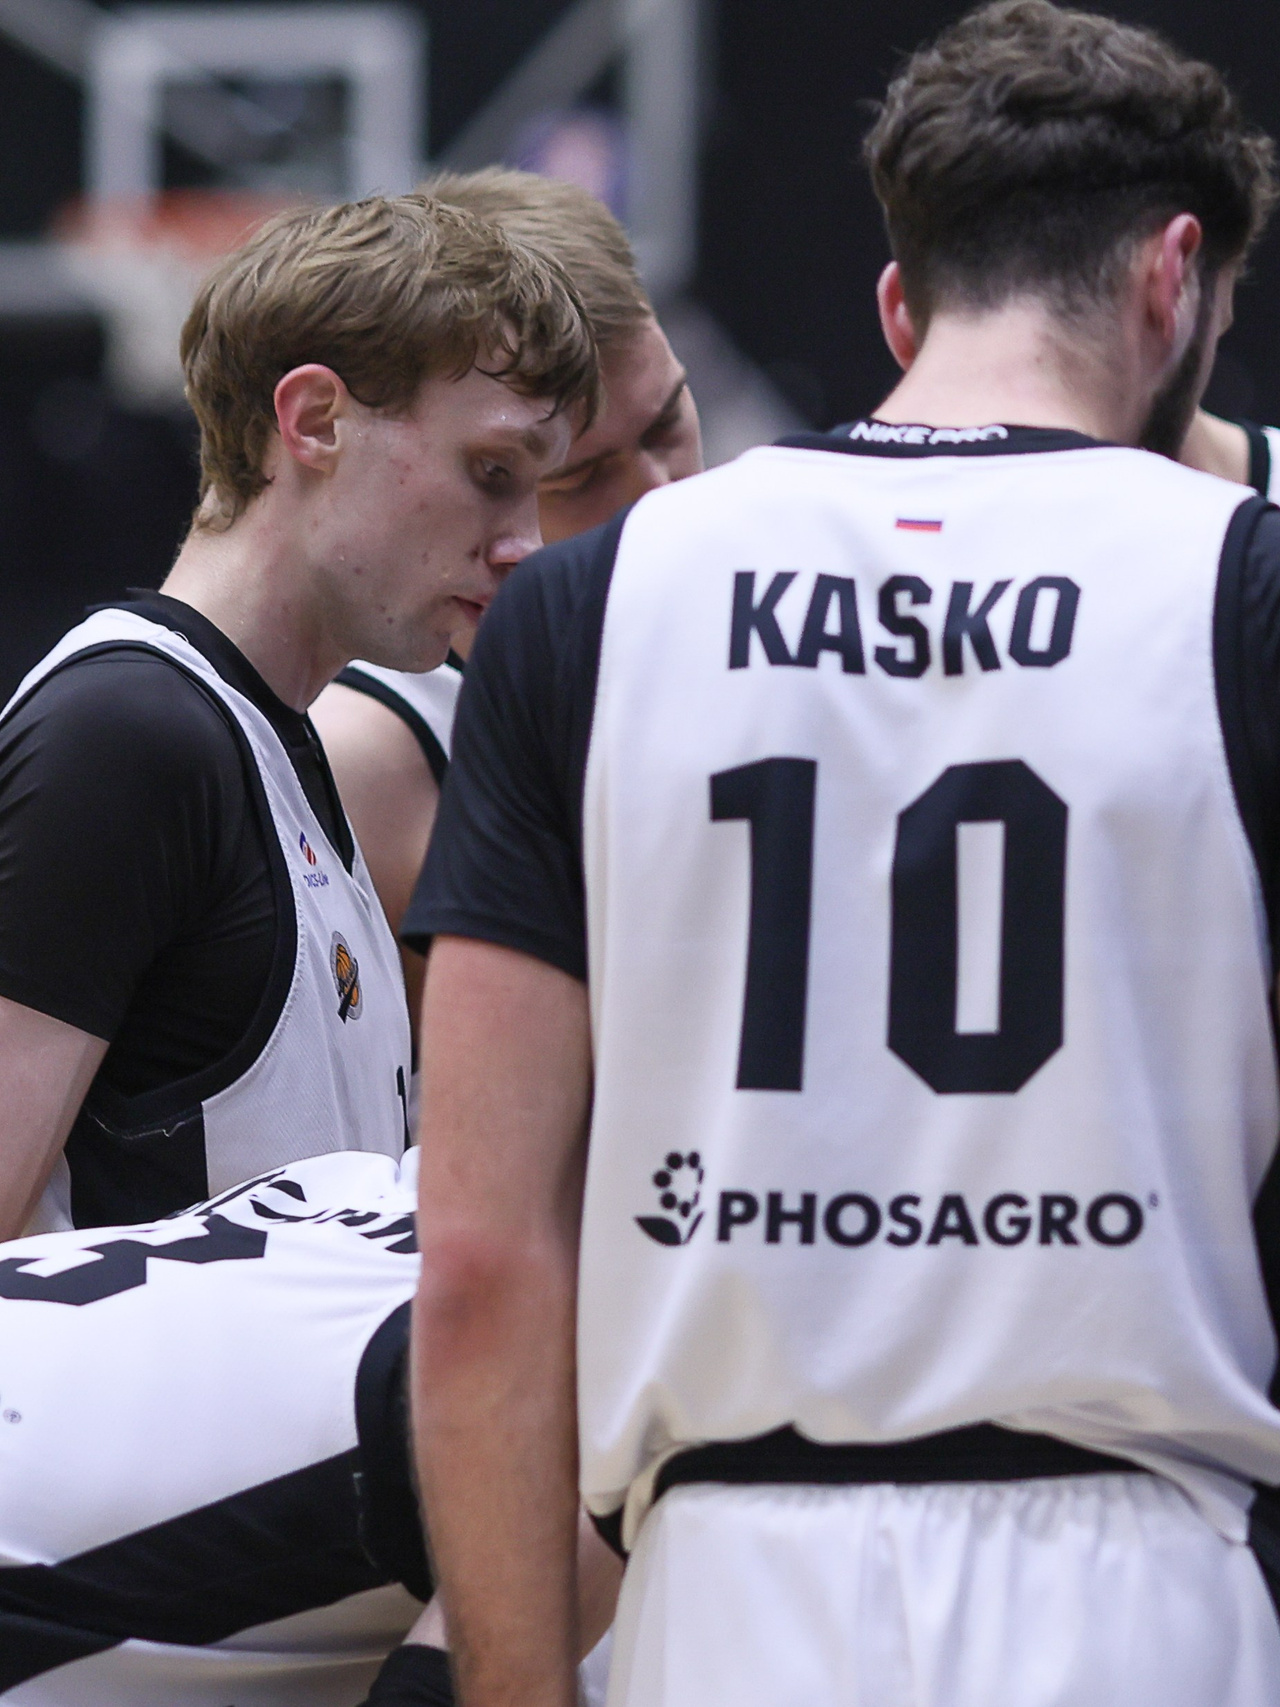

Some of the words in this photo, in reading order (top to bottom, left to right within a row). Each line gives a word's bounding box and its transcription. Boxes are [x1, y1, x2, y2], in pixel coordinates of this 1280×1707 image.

[849, 421, 932, 444] NIKE
[727, 570, 1081, 679] KASKO
[709, 756, 1069, 1095] 10
[716, 1190, 1145, 1248] PHOSAGRO
